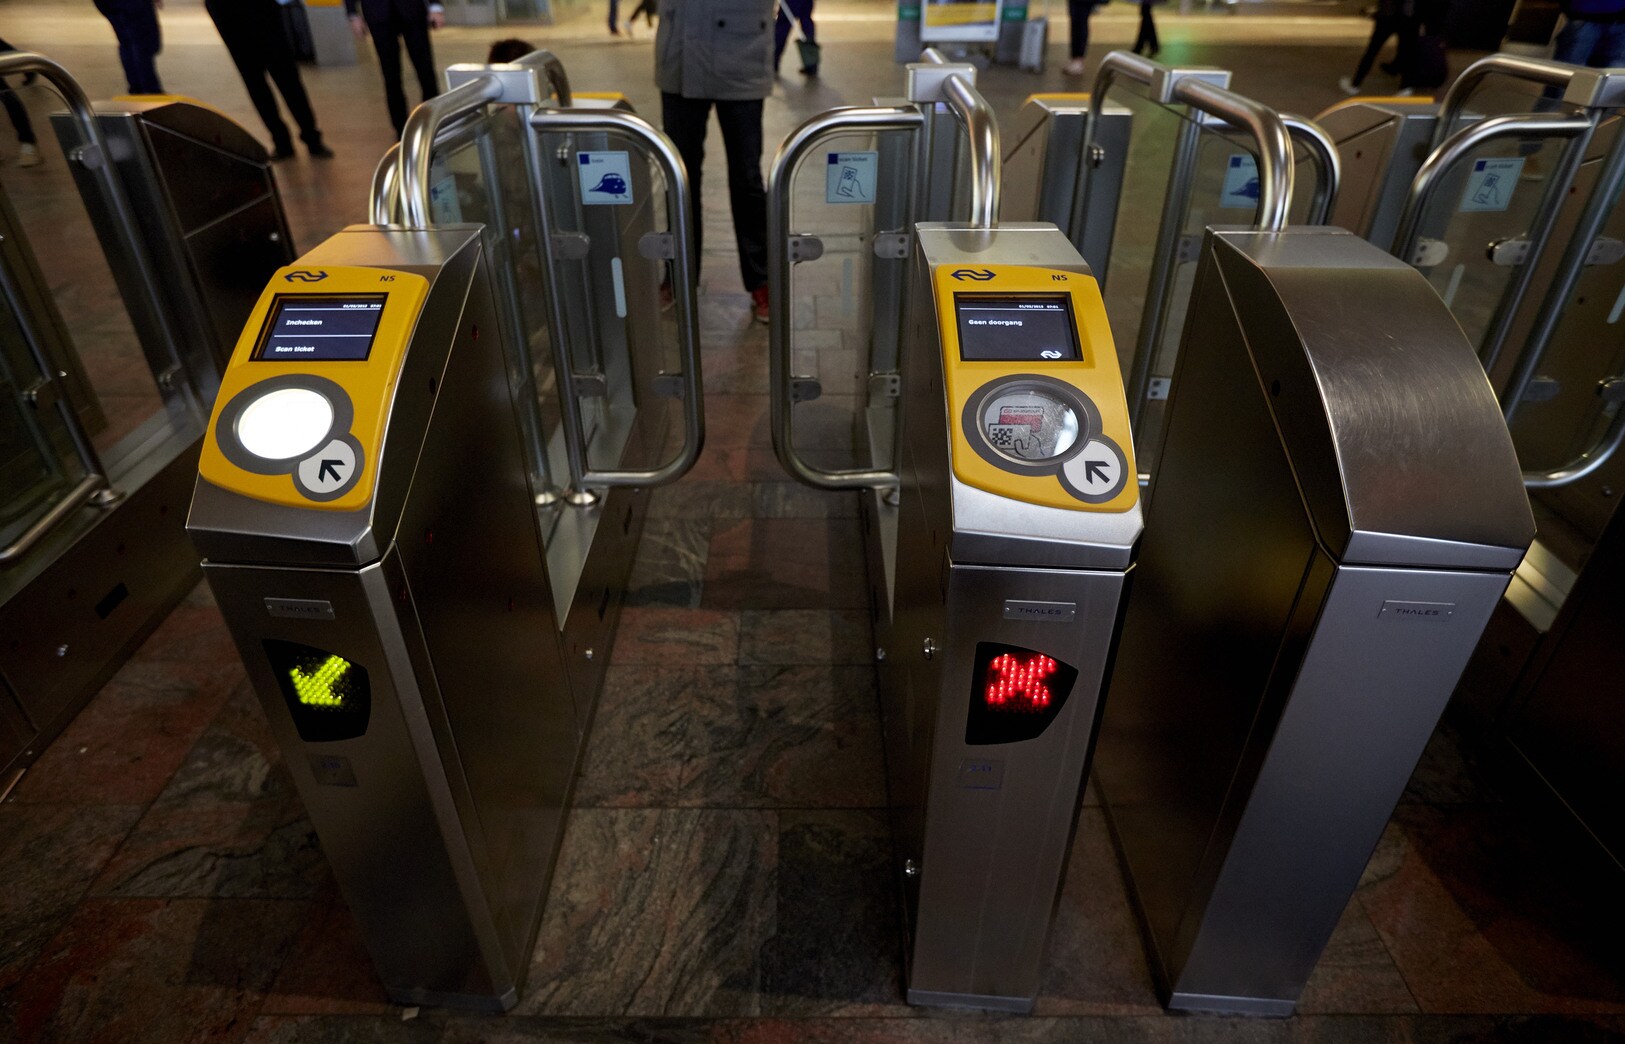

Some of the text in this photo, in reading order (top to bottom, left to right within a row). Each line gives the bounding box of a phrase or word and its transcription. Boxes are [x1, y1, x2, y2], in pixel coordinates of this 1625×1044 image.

[988, 319, 1023, 327] doorgang
[1018, 607, 1062, 615] THALES
[1395, 608, 1440, 616] THALES
